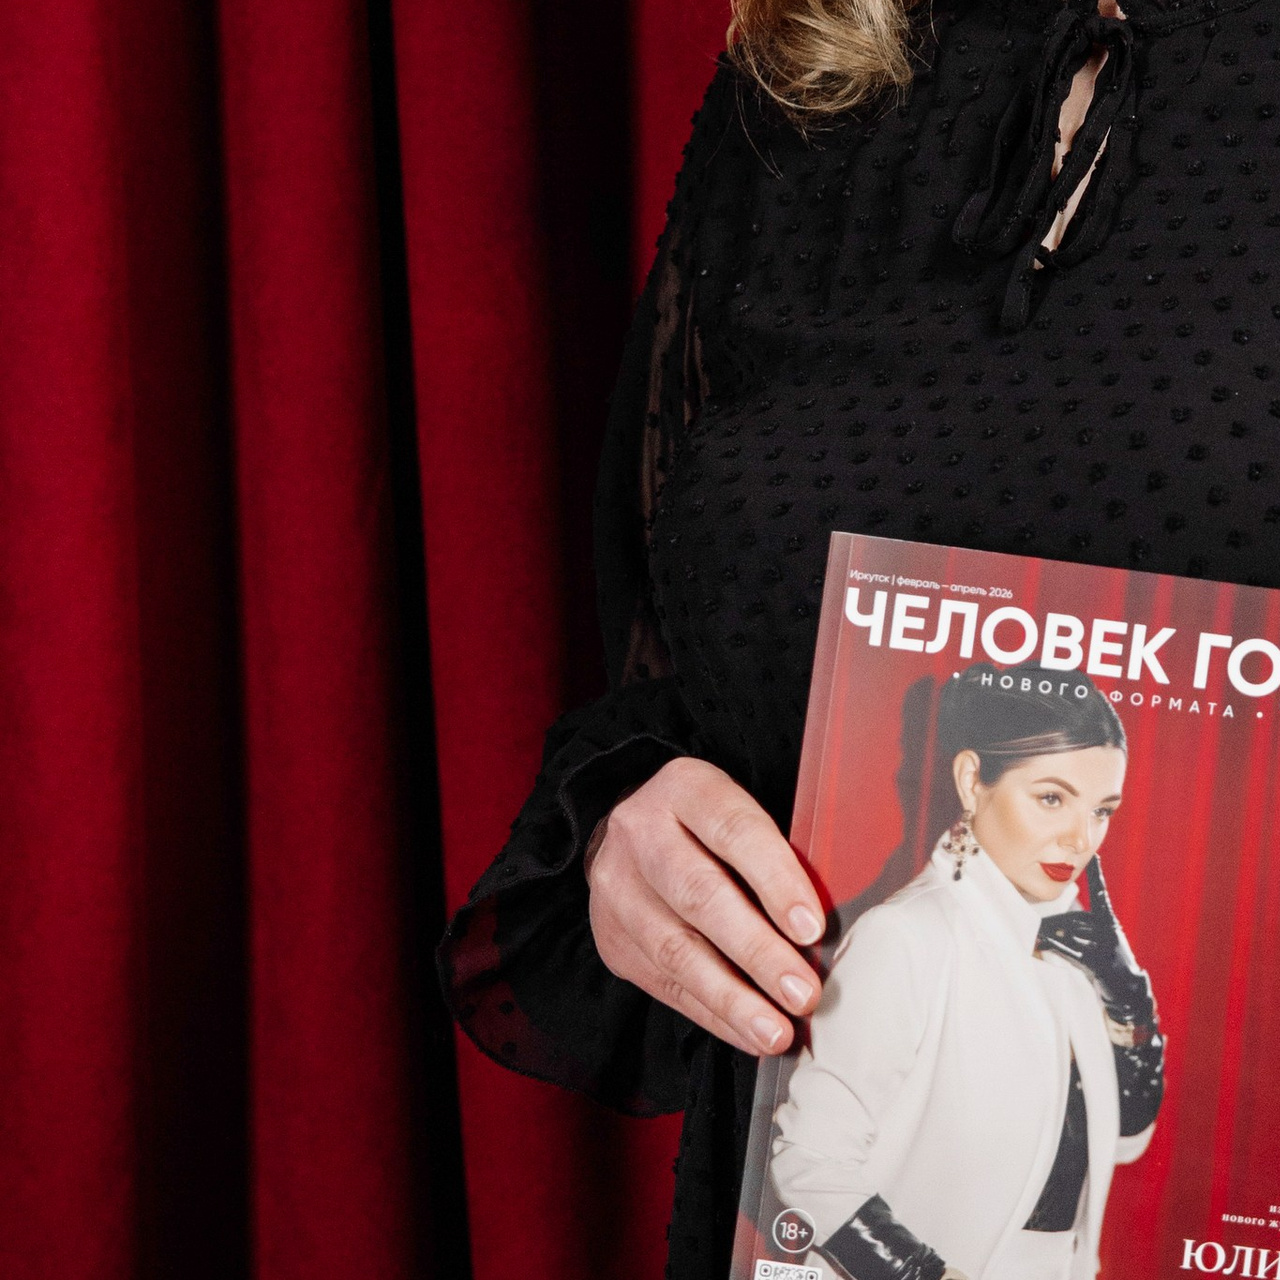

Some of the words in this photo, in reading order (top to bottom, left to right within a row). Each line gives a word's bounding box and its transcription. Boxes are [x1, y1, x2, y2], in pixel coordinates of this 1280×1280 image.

[850, 569, 890, 583] Иркутск
[896, 576, 941, 590] февраль
[950, 584, 987, 596] апрель
[988, 586, 1013, 599] 2026
[845, 587, 1176, 685] ЧЕЛОВЕК
[981, 672, 1089, 699] НОВОГО
[1109, 690, 1235, 718] ФОРМАТА
[780, 1221, 809, 1240] 18+
[1222, 1213, 1266, 1226] нового
